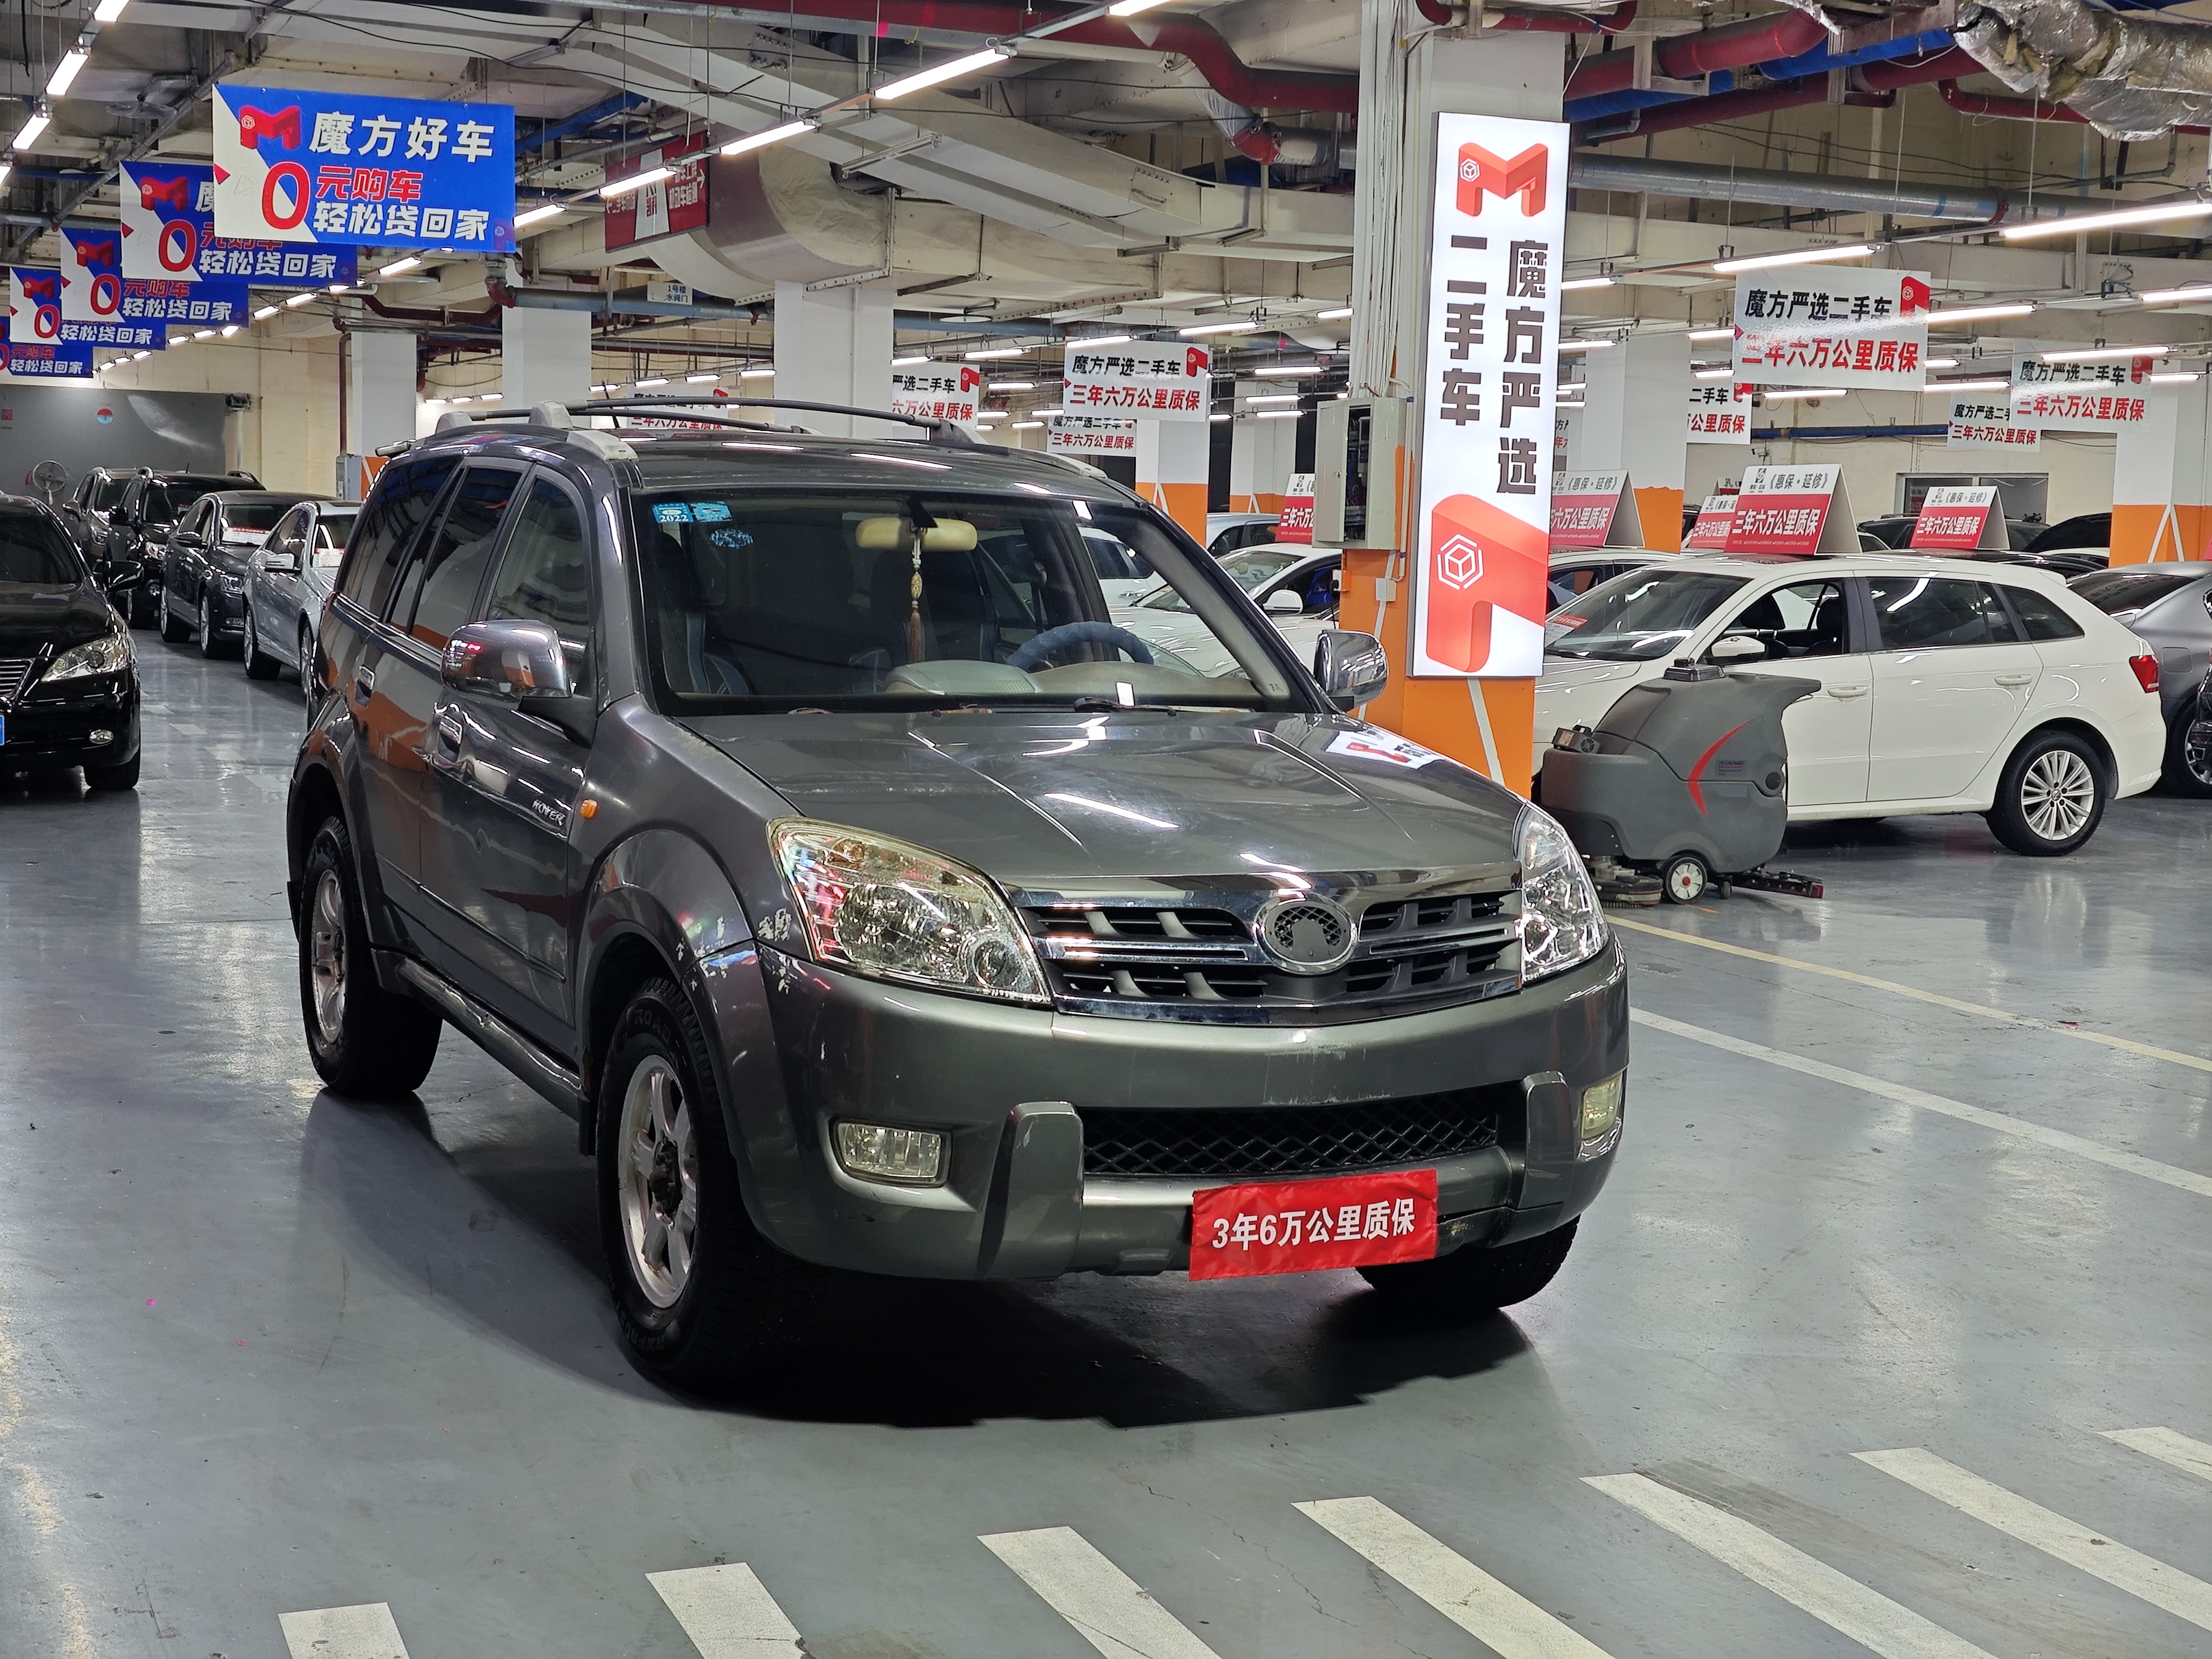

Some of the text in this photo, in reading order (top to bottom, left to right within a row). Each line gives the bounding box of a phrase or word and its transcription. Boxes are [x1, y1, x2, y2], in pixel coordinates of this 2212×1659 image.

[308, 111, 495, 163] 魔方好车
[315, 165, 424, 203] 元购车
[313, 200, 489, 241] 轻松贷回家
[199, 249, 337, 279] 轻松贷回家
[122, 298, 232, 321] 轻松贷回家
[1745, 288, 1892, 323] 魔方严选二手车
[60, 324, 153, 345] 轻松贷回家
[1440, 235, 1488, 426] 二手车
[1072, 355, 1181, 376] 魔方严选二手车
[1741, 334, 1919, 373] 三年六万公里质保
[1496, 240, 1548, 495] 魔方严选
[2020, 360, 2126, 386] 魔方严选二手车
[1070, 385, 1200, 410] 三年六万公里质保
[1689, 387, 1729, 404] 二手车
[2017, 395, 2146, 421] 三年六万公里质保
[892, 400, 973, 420] 六万公里质保
[1052, 433, 1134, 449] 三年六万公里质保
[1952, 425, 2036, 444] 三年六万公里质保
[1732, 509, 1822, 536] 三年六万公里质保
[1917, 516, 1981, 536] 三年六万公里质保
[1212, 1197, 1415, 1251] 3年6万公里质保
